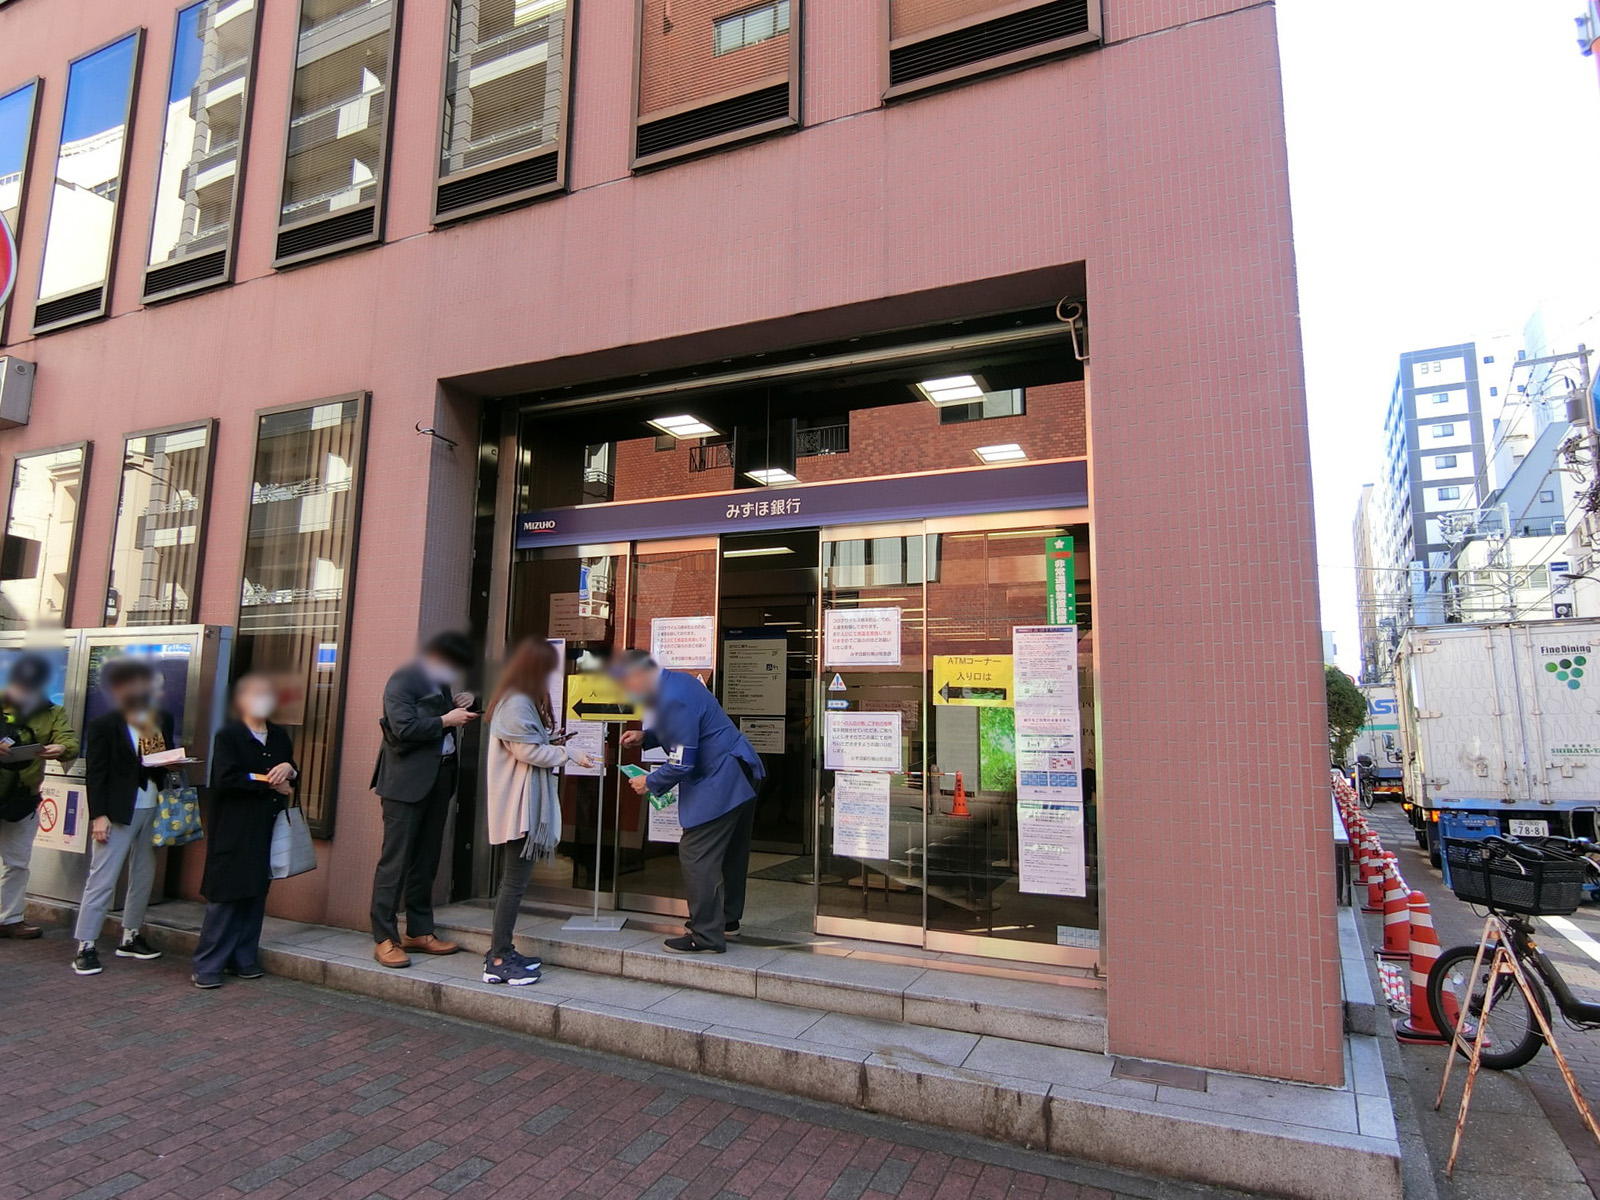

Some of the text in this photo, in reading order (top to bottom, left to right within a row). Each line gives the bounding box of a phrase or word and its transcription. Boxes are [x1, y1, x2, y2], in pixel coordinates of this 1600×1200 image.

[726, 498, 801, 518] みずほ銀行
[524, 520, 556, 530] MIZUHO
[947, 657, 1002, 665] ATMコーナー
[957, 672, 991, 681] 入り口は
